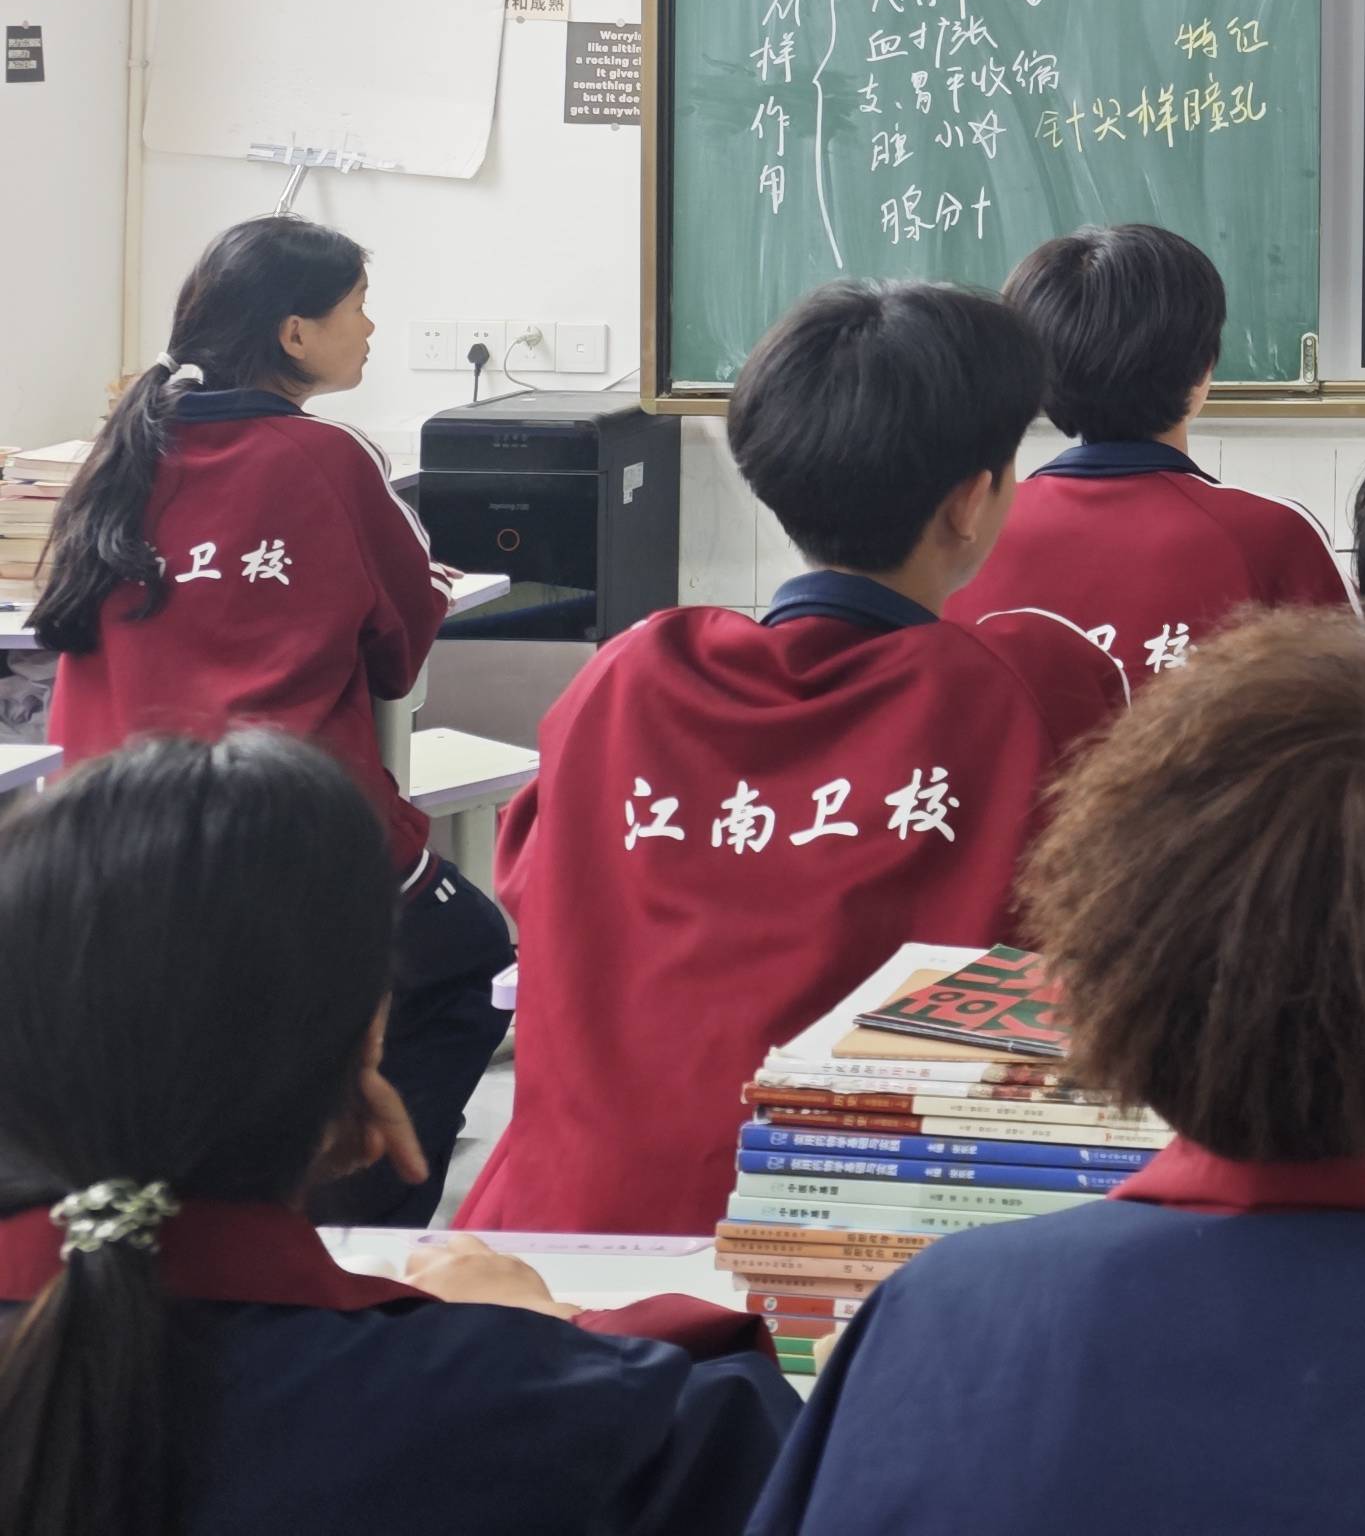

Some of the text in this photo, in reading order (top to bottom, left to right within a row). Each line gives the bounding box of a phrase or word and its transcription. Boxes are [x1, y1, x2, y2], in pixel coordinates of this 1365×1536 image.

[587, 43, 608, 53] like
[586, 56, 629, 67] rocking
[609, 69, 639, 79] gives
[573, 81, 632, 92] something
[583, 93, 603, 102] but
[570, 106, 590, 116] get
[624, 766, 960, 854] 江南卫校
